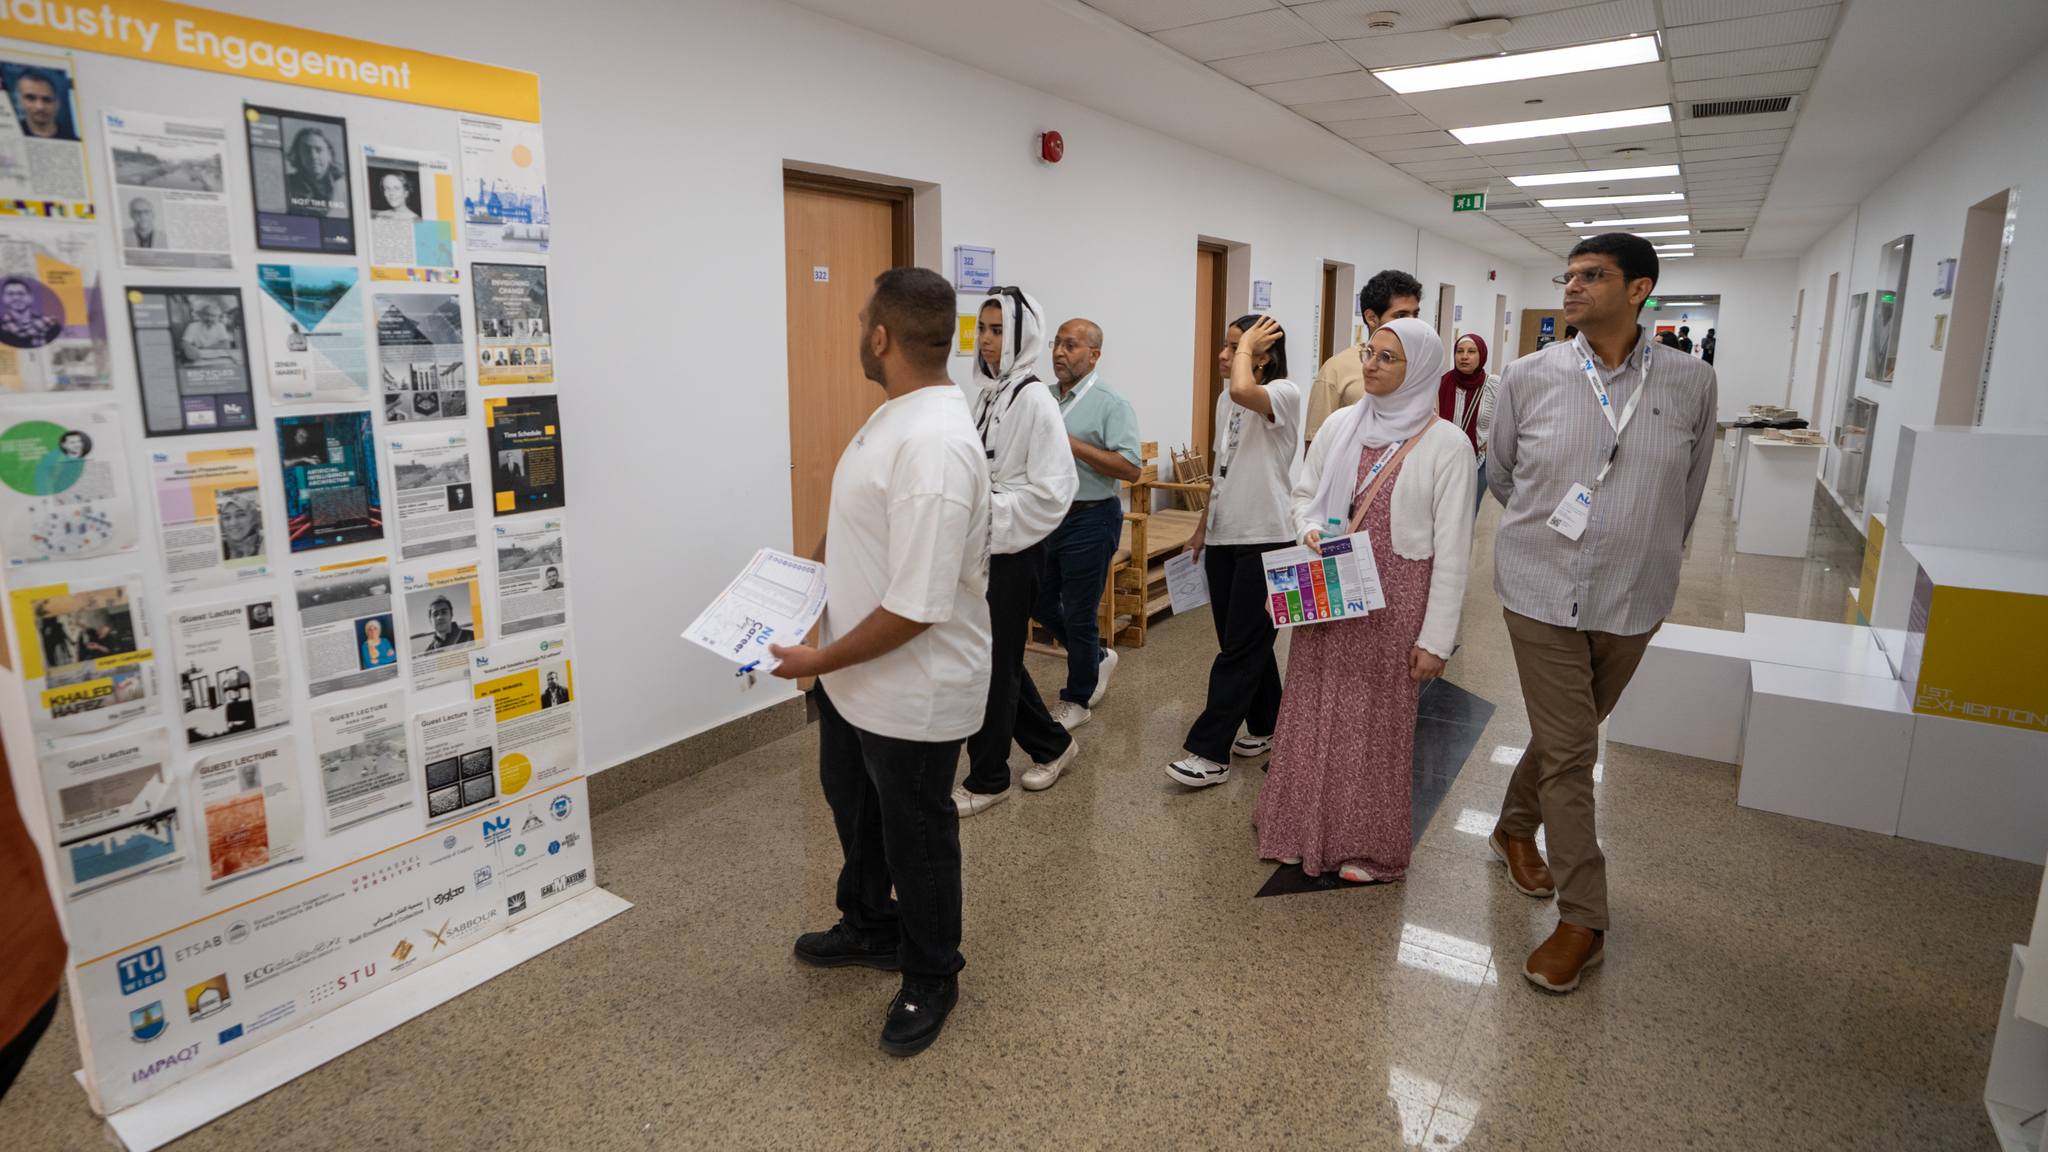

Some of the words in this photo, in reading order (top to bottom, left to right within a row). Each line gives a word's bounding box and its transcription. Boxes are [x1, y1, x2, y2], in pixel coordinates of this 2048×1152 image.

[0, 0, 160, 53] dustry
[174, 21, 410, 90] Engagement
[964, 257, 974, 266] 322
[815, 271, 827, 280] 322
[178, 613, 207, 625] Guest
[209, 607, 242, 619] Lecture
[733, 621, 763, 653] Career
[755, 626, 776, 646] NU
[49, 685, 113, 706] KHALED
[1922, 684, 1953, 698] 1ST
[51, 698, 105, 719] HAFEZ
[329, 711, 355, 723] GUEST
[356, 703, 389, 717] LECTURE
[421, 717, 443, 727] Guest
[443, 712, 468, 722] Lecture
[1915, 695, 2048, 727] EXHIBITION
[67, 757, 99, 770] Guest
[102, 746, 140, 761] Lecture
[200, 761, 233, 775] GUEST
[234, 749, 279, 766] LECTURE
[483, 816, 510, 837] NU
[447, 908, 498, 938] SABBOUR
[175, 935, 223, 963] ETSAB
[119, 950, 161, 981] TU
[243, 964, 275, 984] ECG
[337, 962, 376, 991] STU
[124, 969, 164, 992] WIEN
[132, 1041, 201, 1083] IMPAQT
